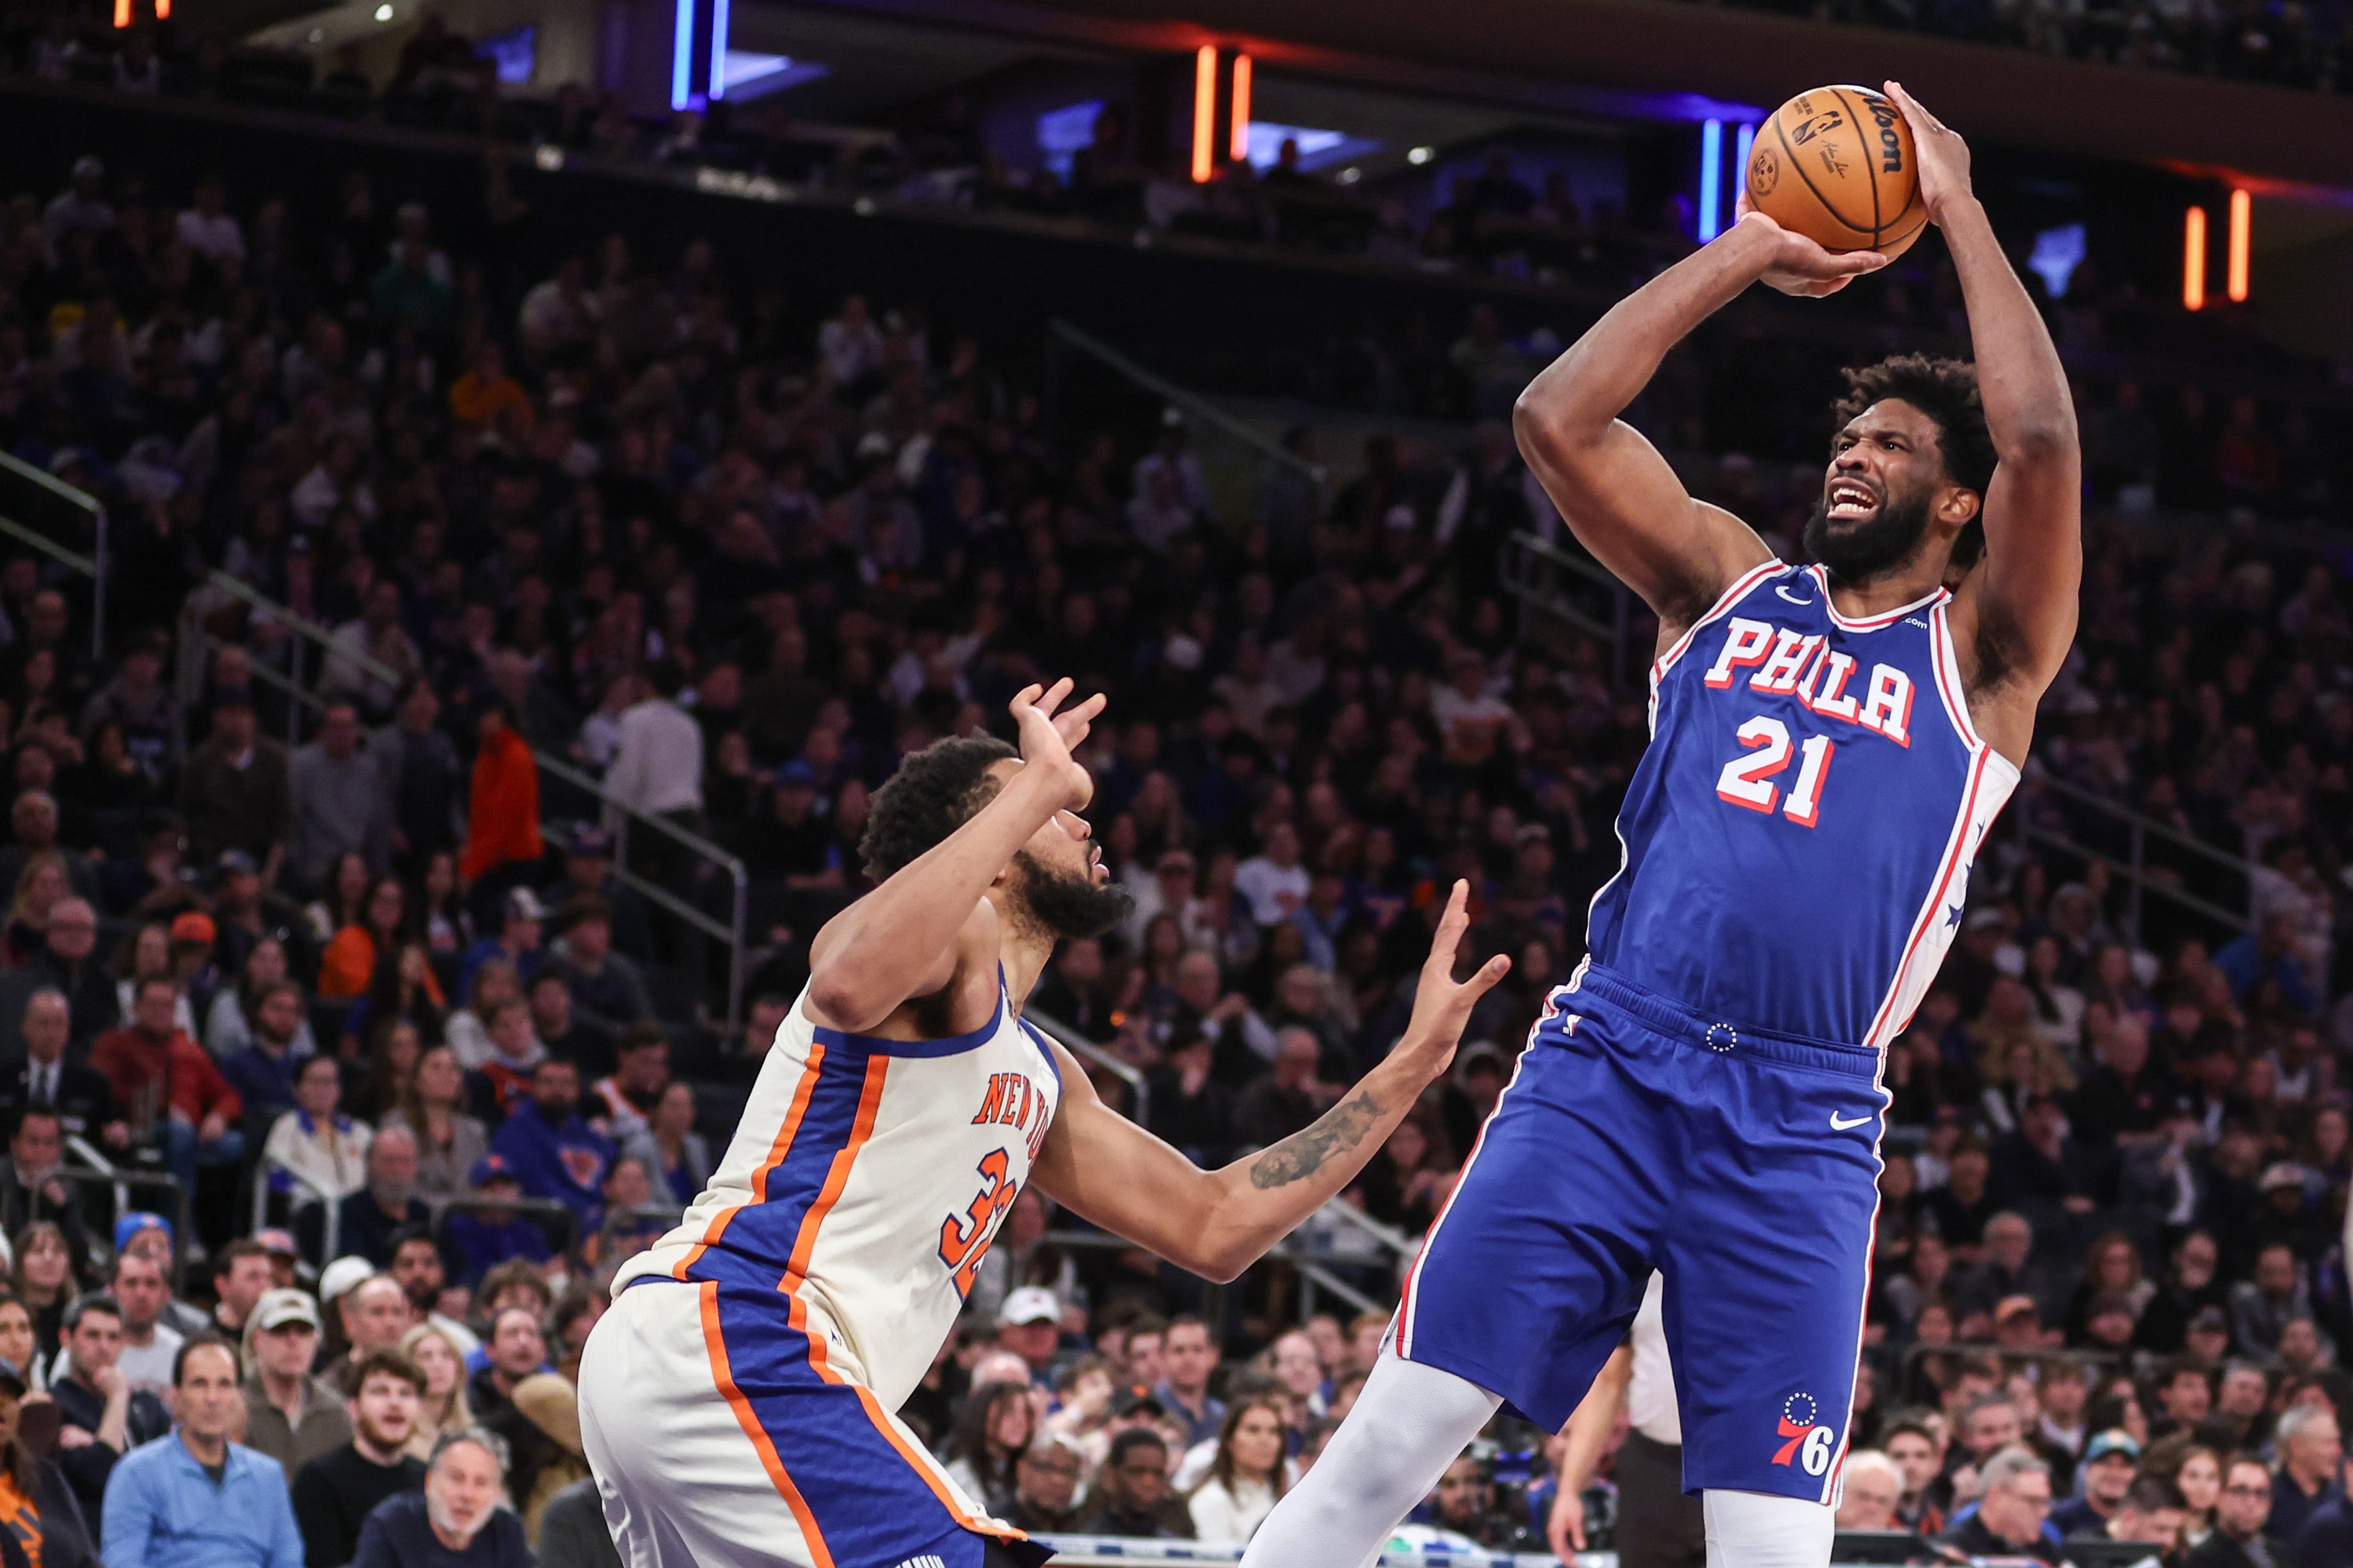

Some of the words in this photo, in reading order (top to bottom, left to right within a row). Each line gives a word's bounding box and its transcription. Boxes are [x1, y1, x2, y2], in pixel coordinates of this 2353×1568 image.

[1704, 617, 1915, 749] PHILA
[1716, 715, 1835, 828] 21
[938, 1146, 1017, 1305] 32
[1771, 1414, 1834, 1476] 76
